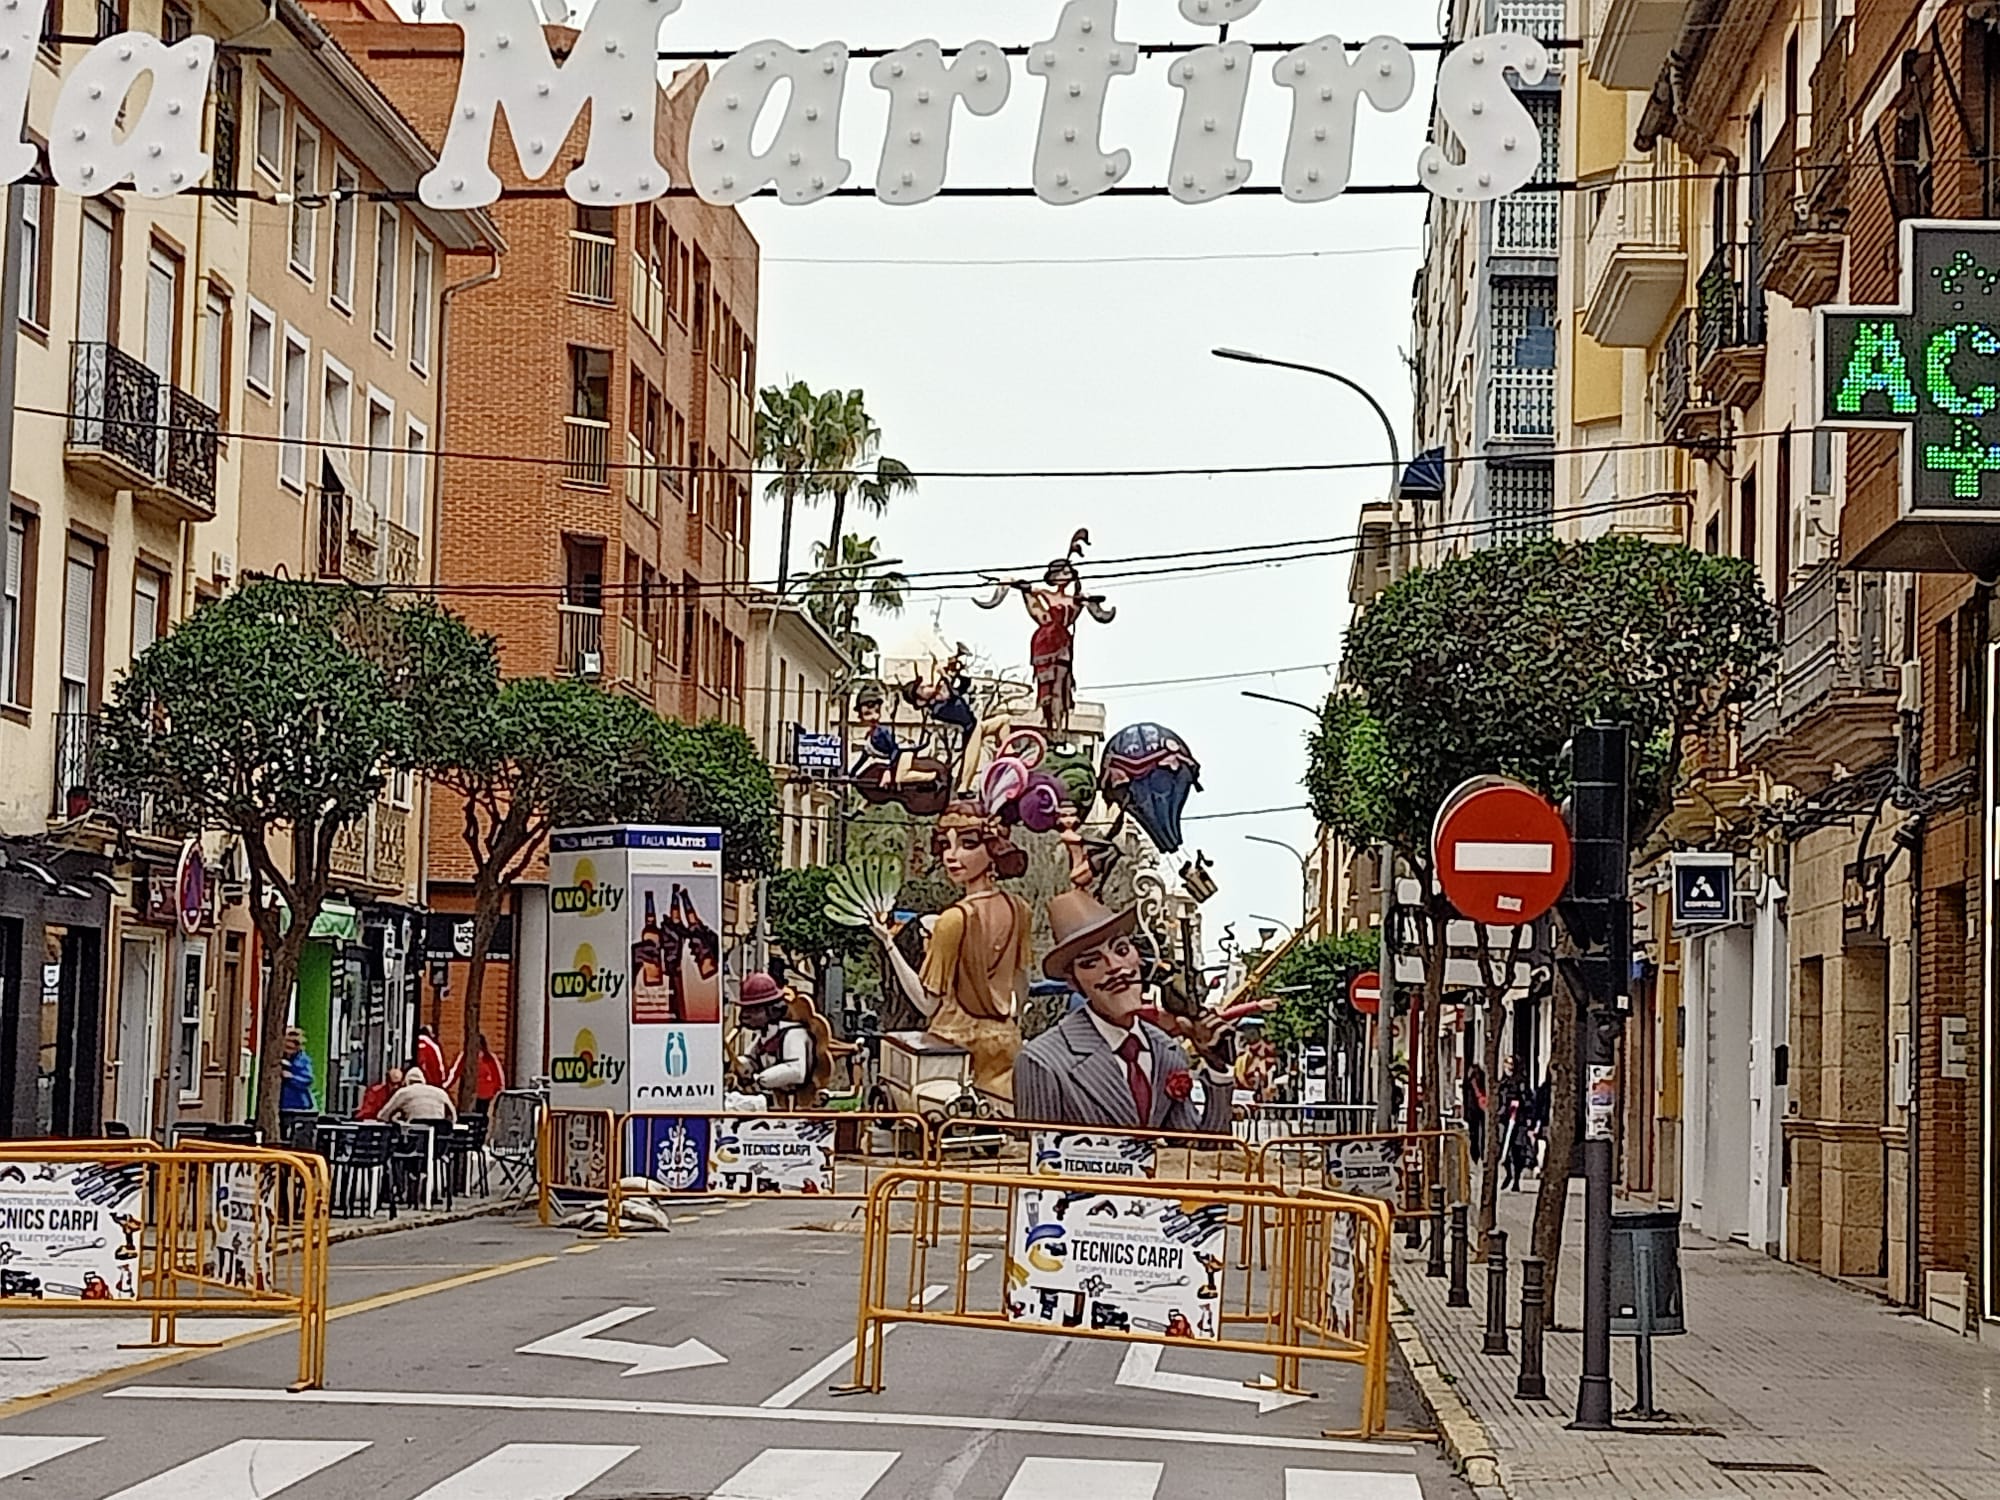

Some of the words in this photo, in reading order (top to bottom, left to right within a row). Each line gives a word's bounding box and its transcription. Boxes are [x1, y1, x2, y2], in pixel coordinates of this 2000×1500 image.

[419, 0, 1548, 210] Martirs
[641, 835, 665, 847] FALLA
[637, 1084, 715, 1098] COMAVI
[743, 1143, 781, 1156] TECNICS
[783, 1144, 811, 1157] CARPI
[1064, 1159, 1103, 1174] TECNICS
[1105, 1161, 1133, 1177] CARPI
[49, 1208, 99, 1232] CARPI
[1071, 1239, 1135, 1265] TECNICS
[1137, 1244, 1184, 1270] CARPI
